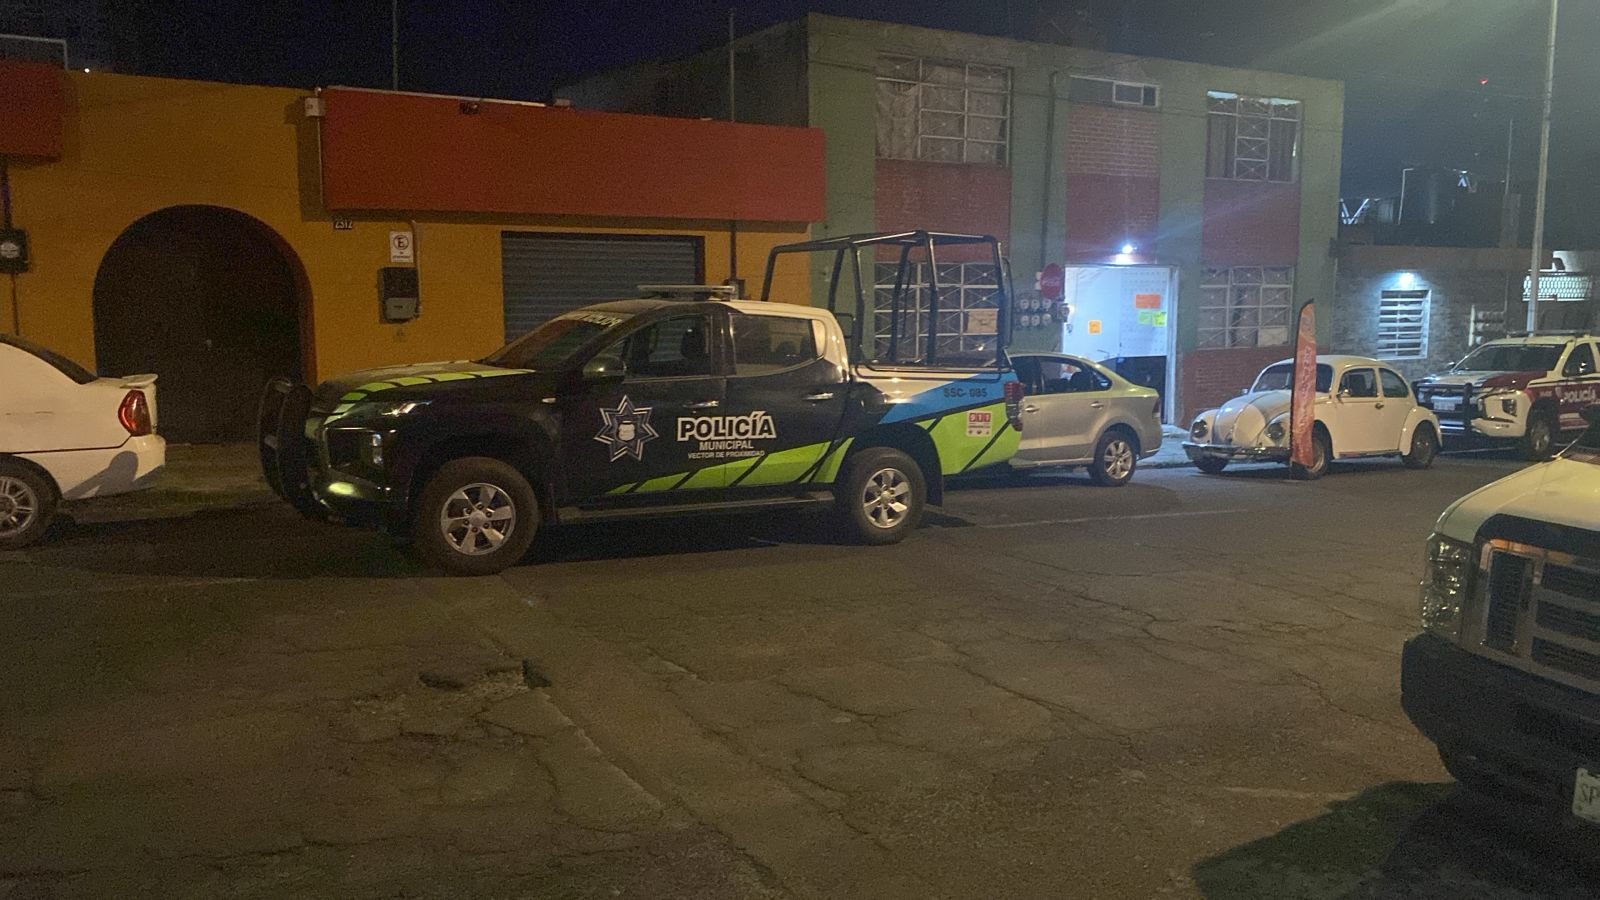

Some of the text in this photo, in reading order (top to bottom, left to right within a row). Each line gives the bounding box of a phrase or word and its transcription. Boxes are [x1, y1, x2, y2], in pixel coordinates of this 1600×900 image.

[969, 413, 991, 422] 911
[677, 411, 777, 441] POLICÍA
[699, 440, 754, 451] MUNICIPAL
